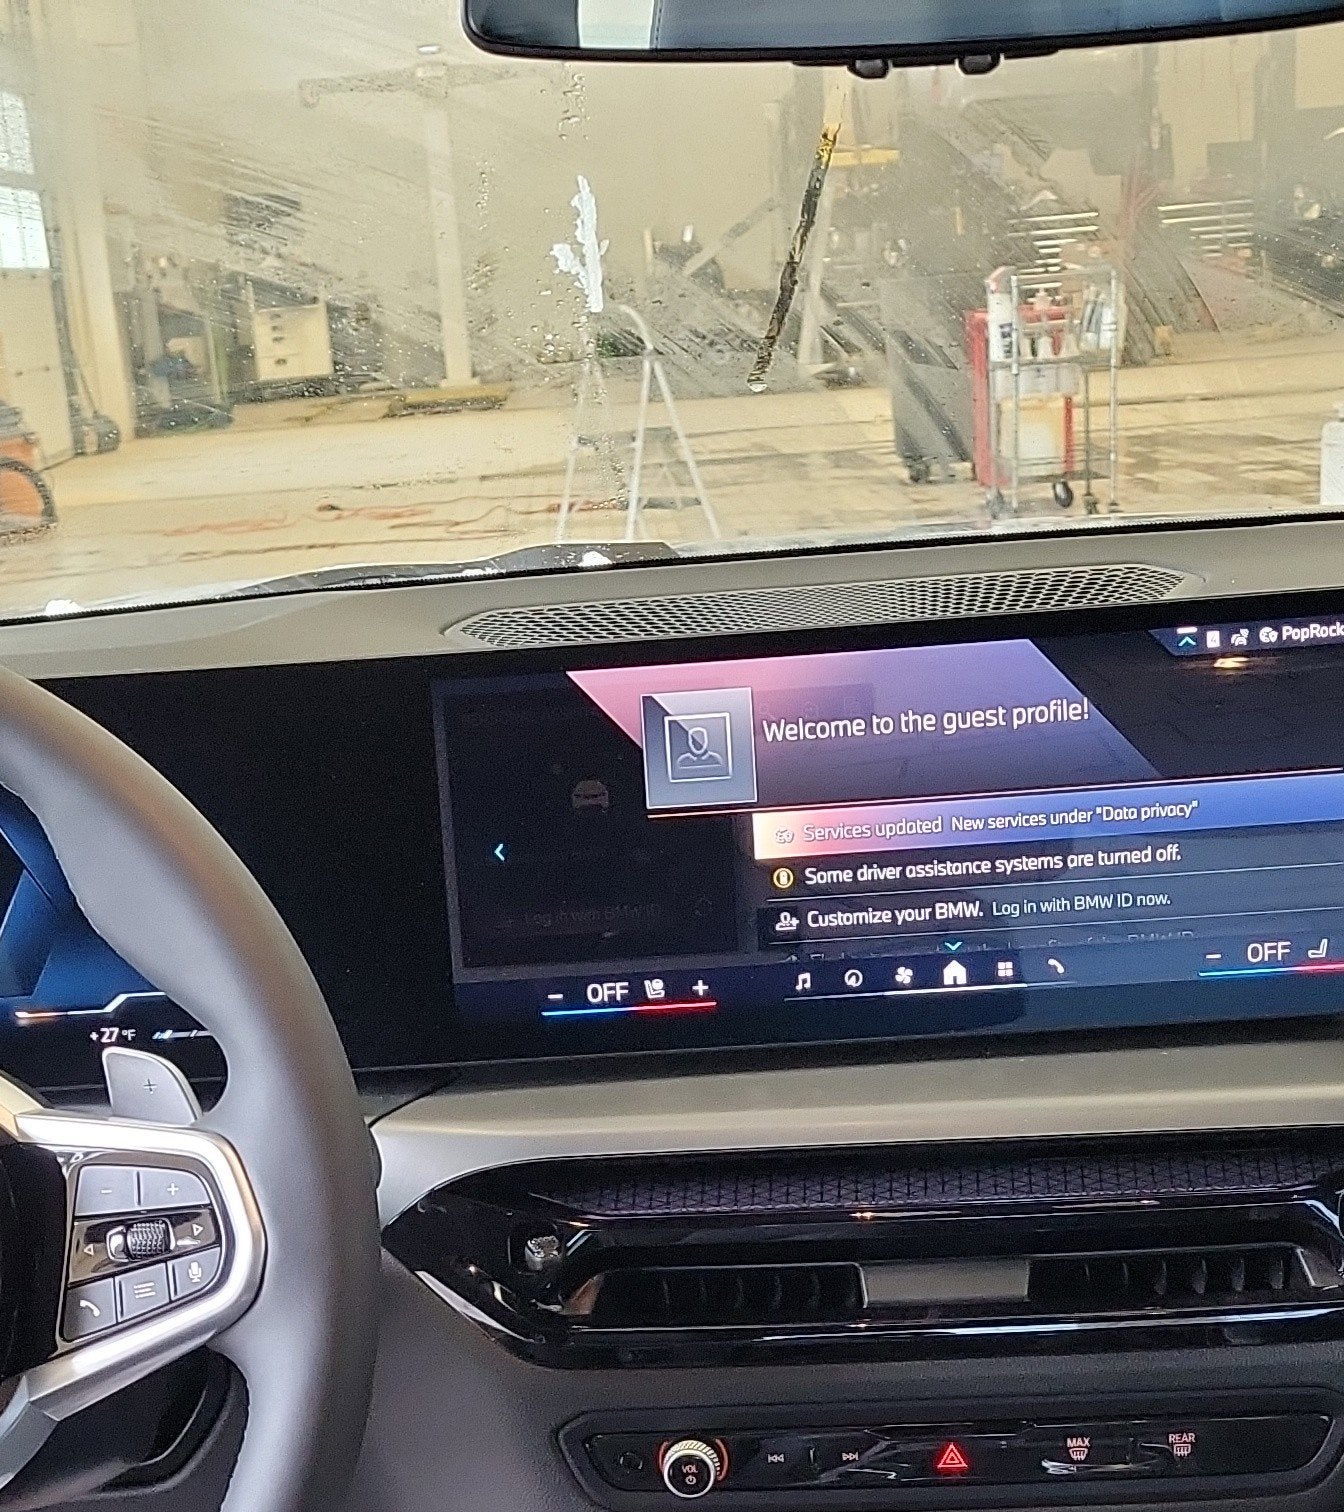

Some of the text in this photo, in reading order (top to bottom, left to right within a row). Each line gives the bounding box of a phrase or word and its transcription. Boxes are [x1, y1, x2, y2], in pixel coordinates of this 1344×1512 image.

[762, 697, 1089, 742] Welcome to the guest profile!
[803, 800, 1199, 842] Services updated New services under "Data privacy"
[805, 843, 1182, 885] Some driver assistance systems are turned off.
[807, 893, 1171, 928] Customize your BMW. Log in with BMW ID now.
[1247, 941, 1291, 963] OFF
[586, 981, 629, 1003] OFF
[1067, 1436, 1090, 1448] MAX
[1169, 1432, 1196, 1444] REAR
[681, 1463, 698, 1474] VOL
